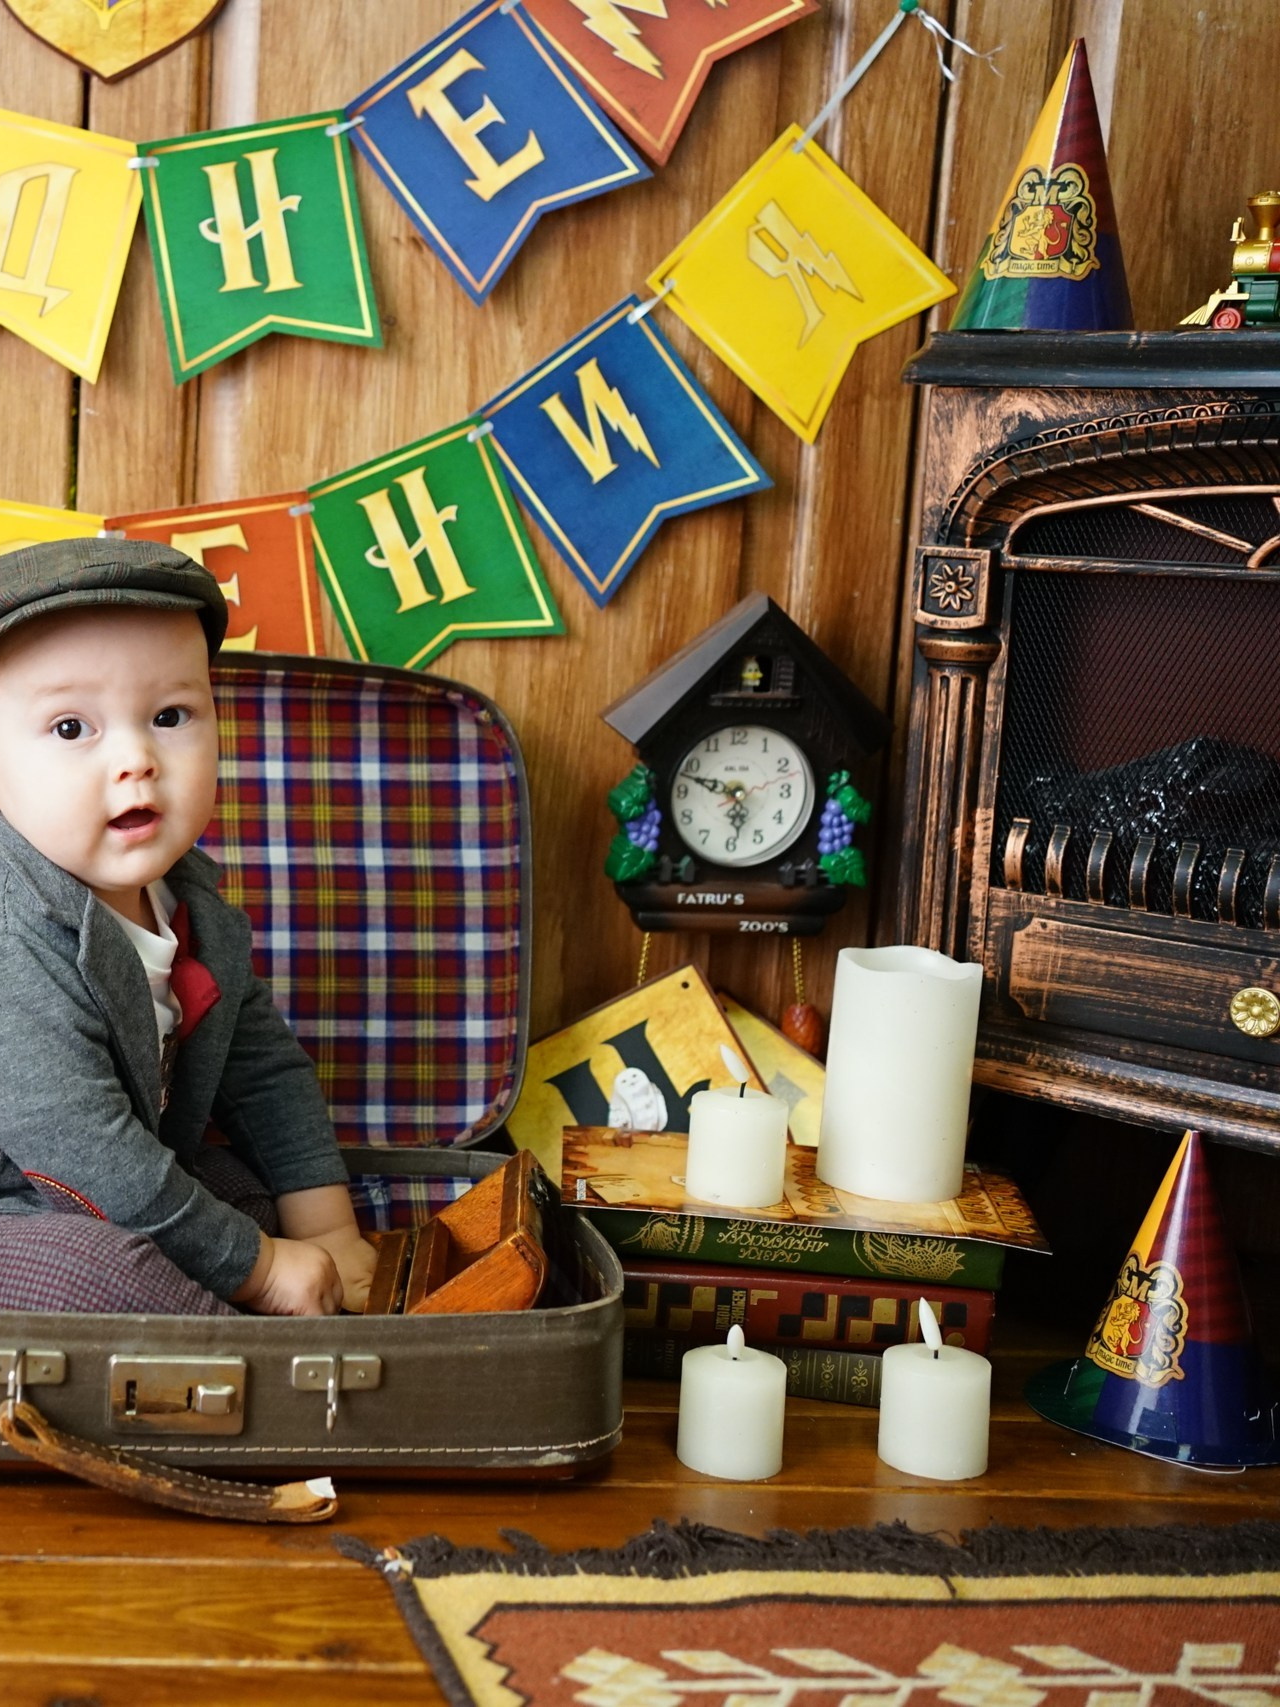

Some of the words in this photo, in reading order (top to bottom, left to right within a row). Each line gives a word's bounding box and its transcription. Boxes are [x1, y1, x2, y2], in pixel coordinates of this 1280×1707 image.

[730, 730, 748, 745] 12
[705, 738, 719, 753] 11
[762, 738, 768, 753] 1
[777, 758, 789, 773] 2
[677, 784, 688, 799] 9
[780, 783, 791, 799] 3
[681, 810, 692, 825] 8
[773, 810, 783, 824] 4
[699, 829, 710, 845] 7
[725, 837, 736, 852] 6
[753, 830, 763, 844] 5
